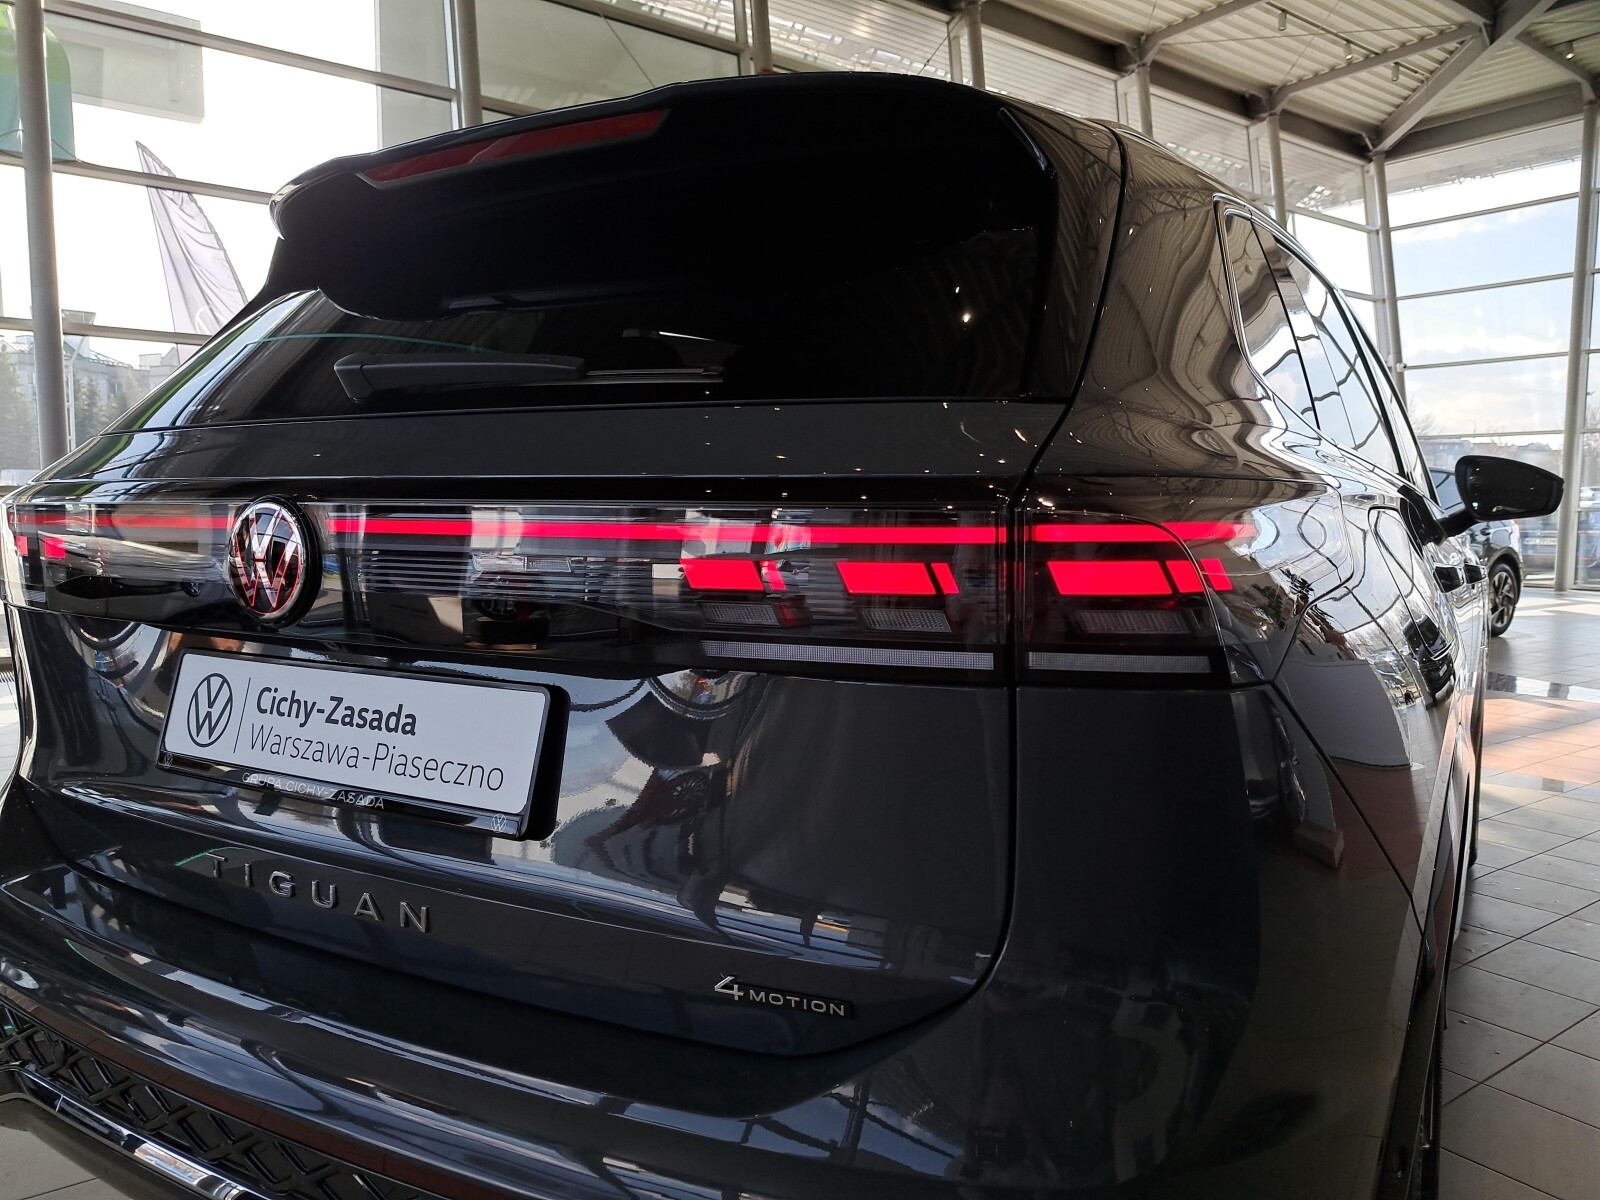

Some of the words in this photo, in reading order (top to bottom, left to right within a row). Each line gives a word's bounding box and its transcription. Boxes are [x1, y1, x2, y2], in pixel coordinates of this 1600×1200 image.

[256, 686, 417, 736] Cichy-Zasada
[250, 723, 504, 791] Warszawa-Piaseczno
[242, 772, 282, 790] GRUPA
[285, 780, 385, 810] CICHY-ZASADA
[205, 852, 430, 934] TIGUAN
